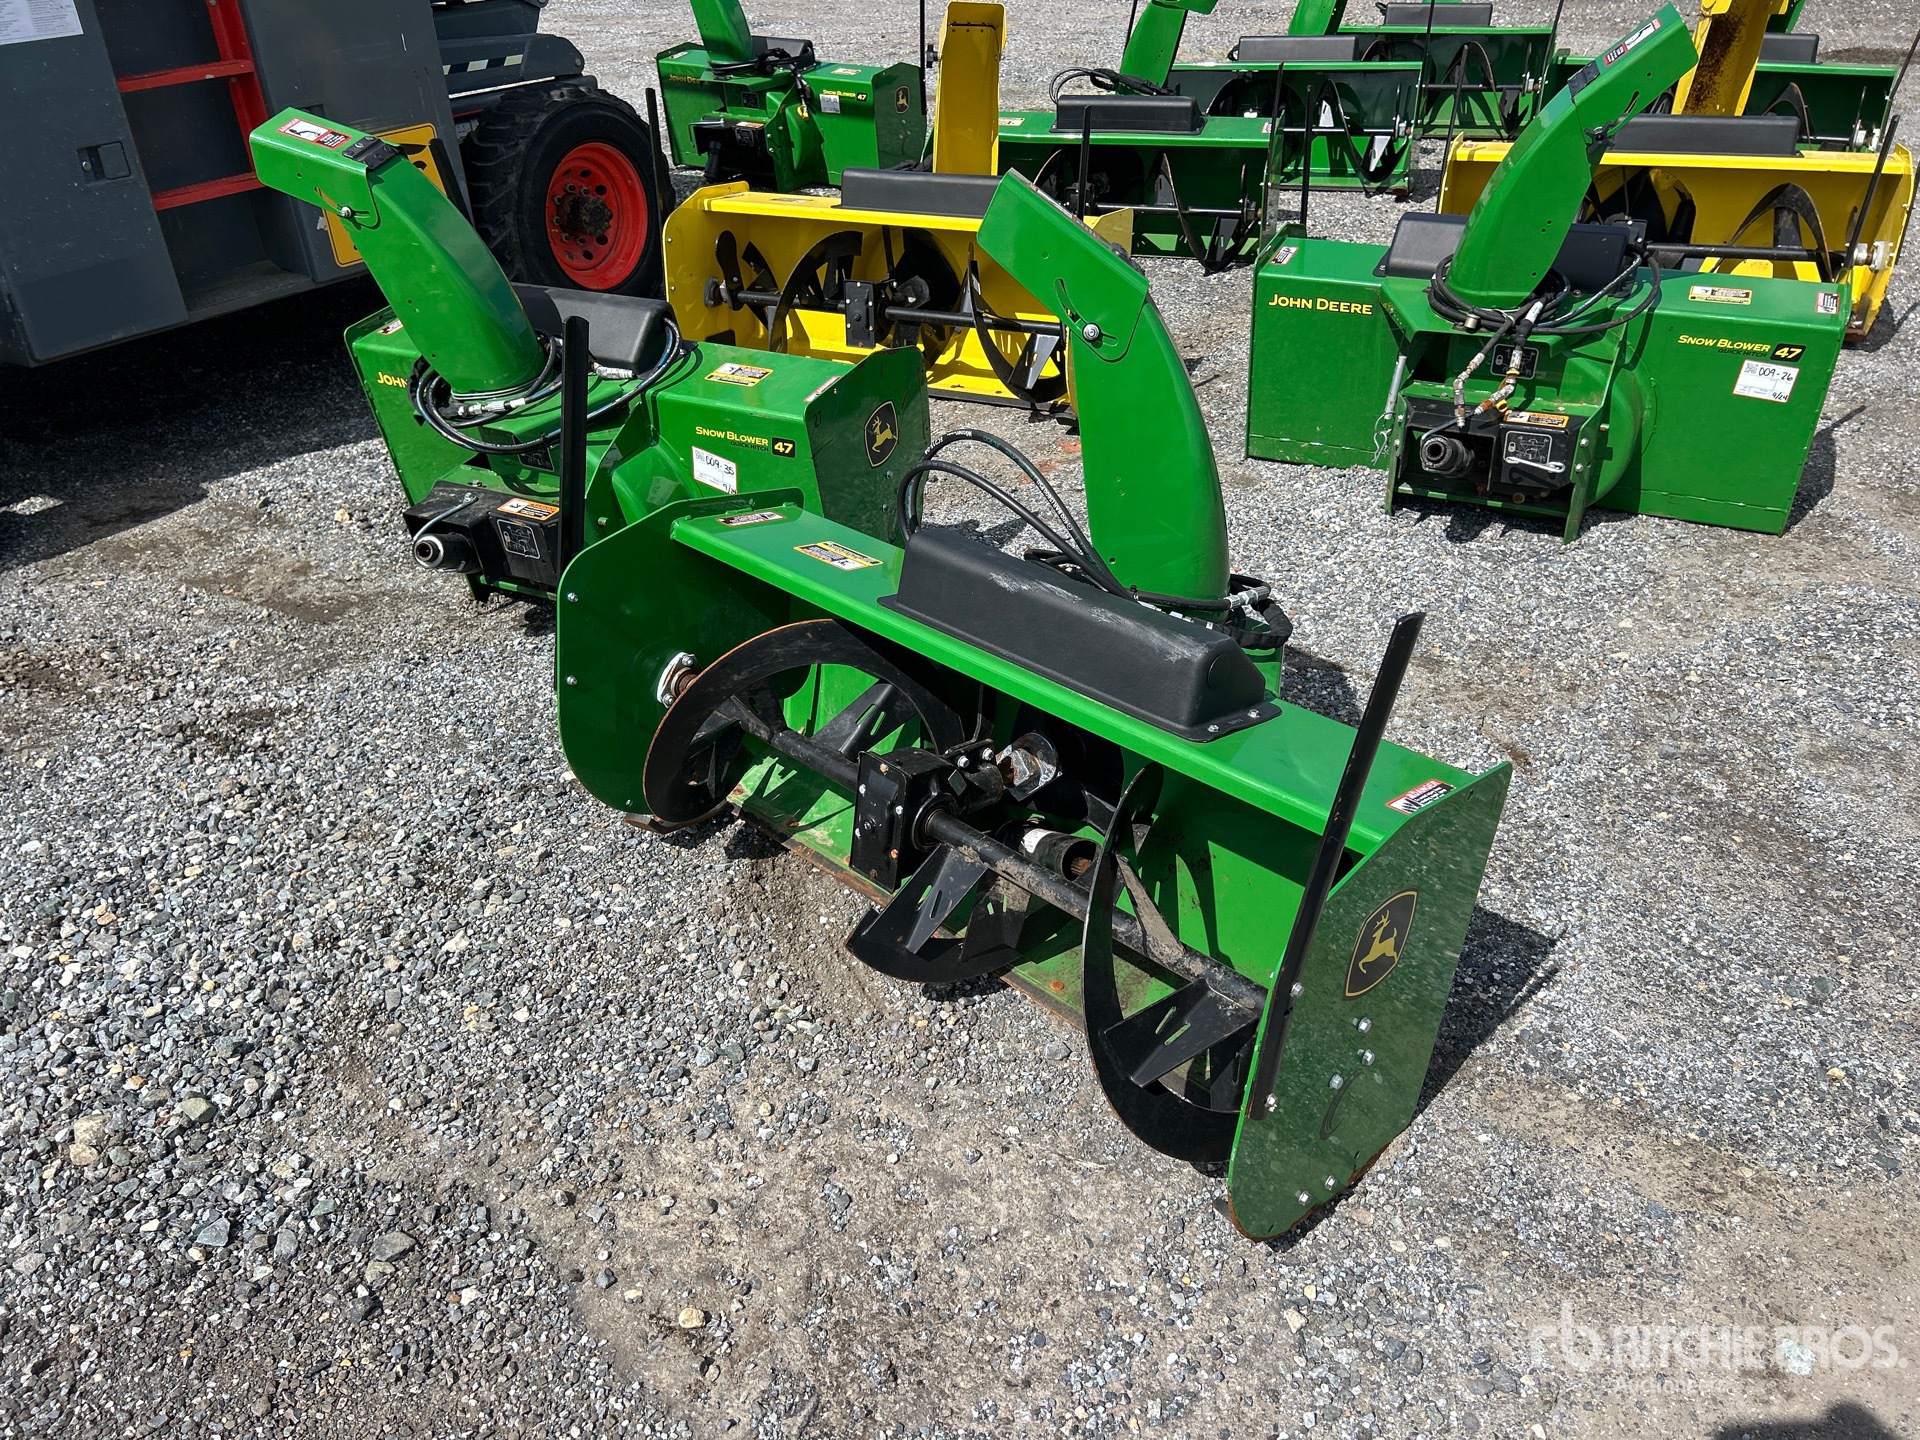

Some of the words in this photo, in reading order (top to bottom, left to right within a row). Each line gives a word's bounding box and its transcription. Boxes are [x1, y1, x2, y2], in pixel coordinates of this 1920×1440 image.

[1269, 294, 1313, 310] JOHN
[1316, 298, 1373, 315] DEERE
[1678, 335, 1717, 346] SNOW
[1716, 338, 1771, 352] BLOWER
[1774, 347, 1802, 359] 47
[696, 426, 725, 439] SNOW
[726, 431, 768, 446] BLOWER
[774, 442, 794, 454] 47
